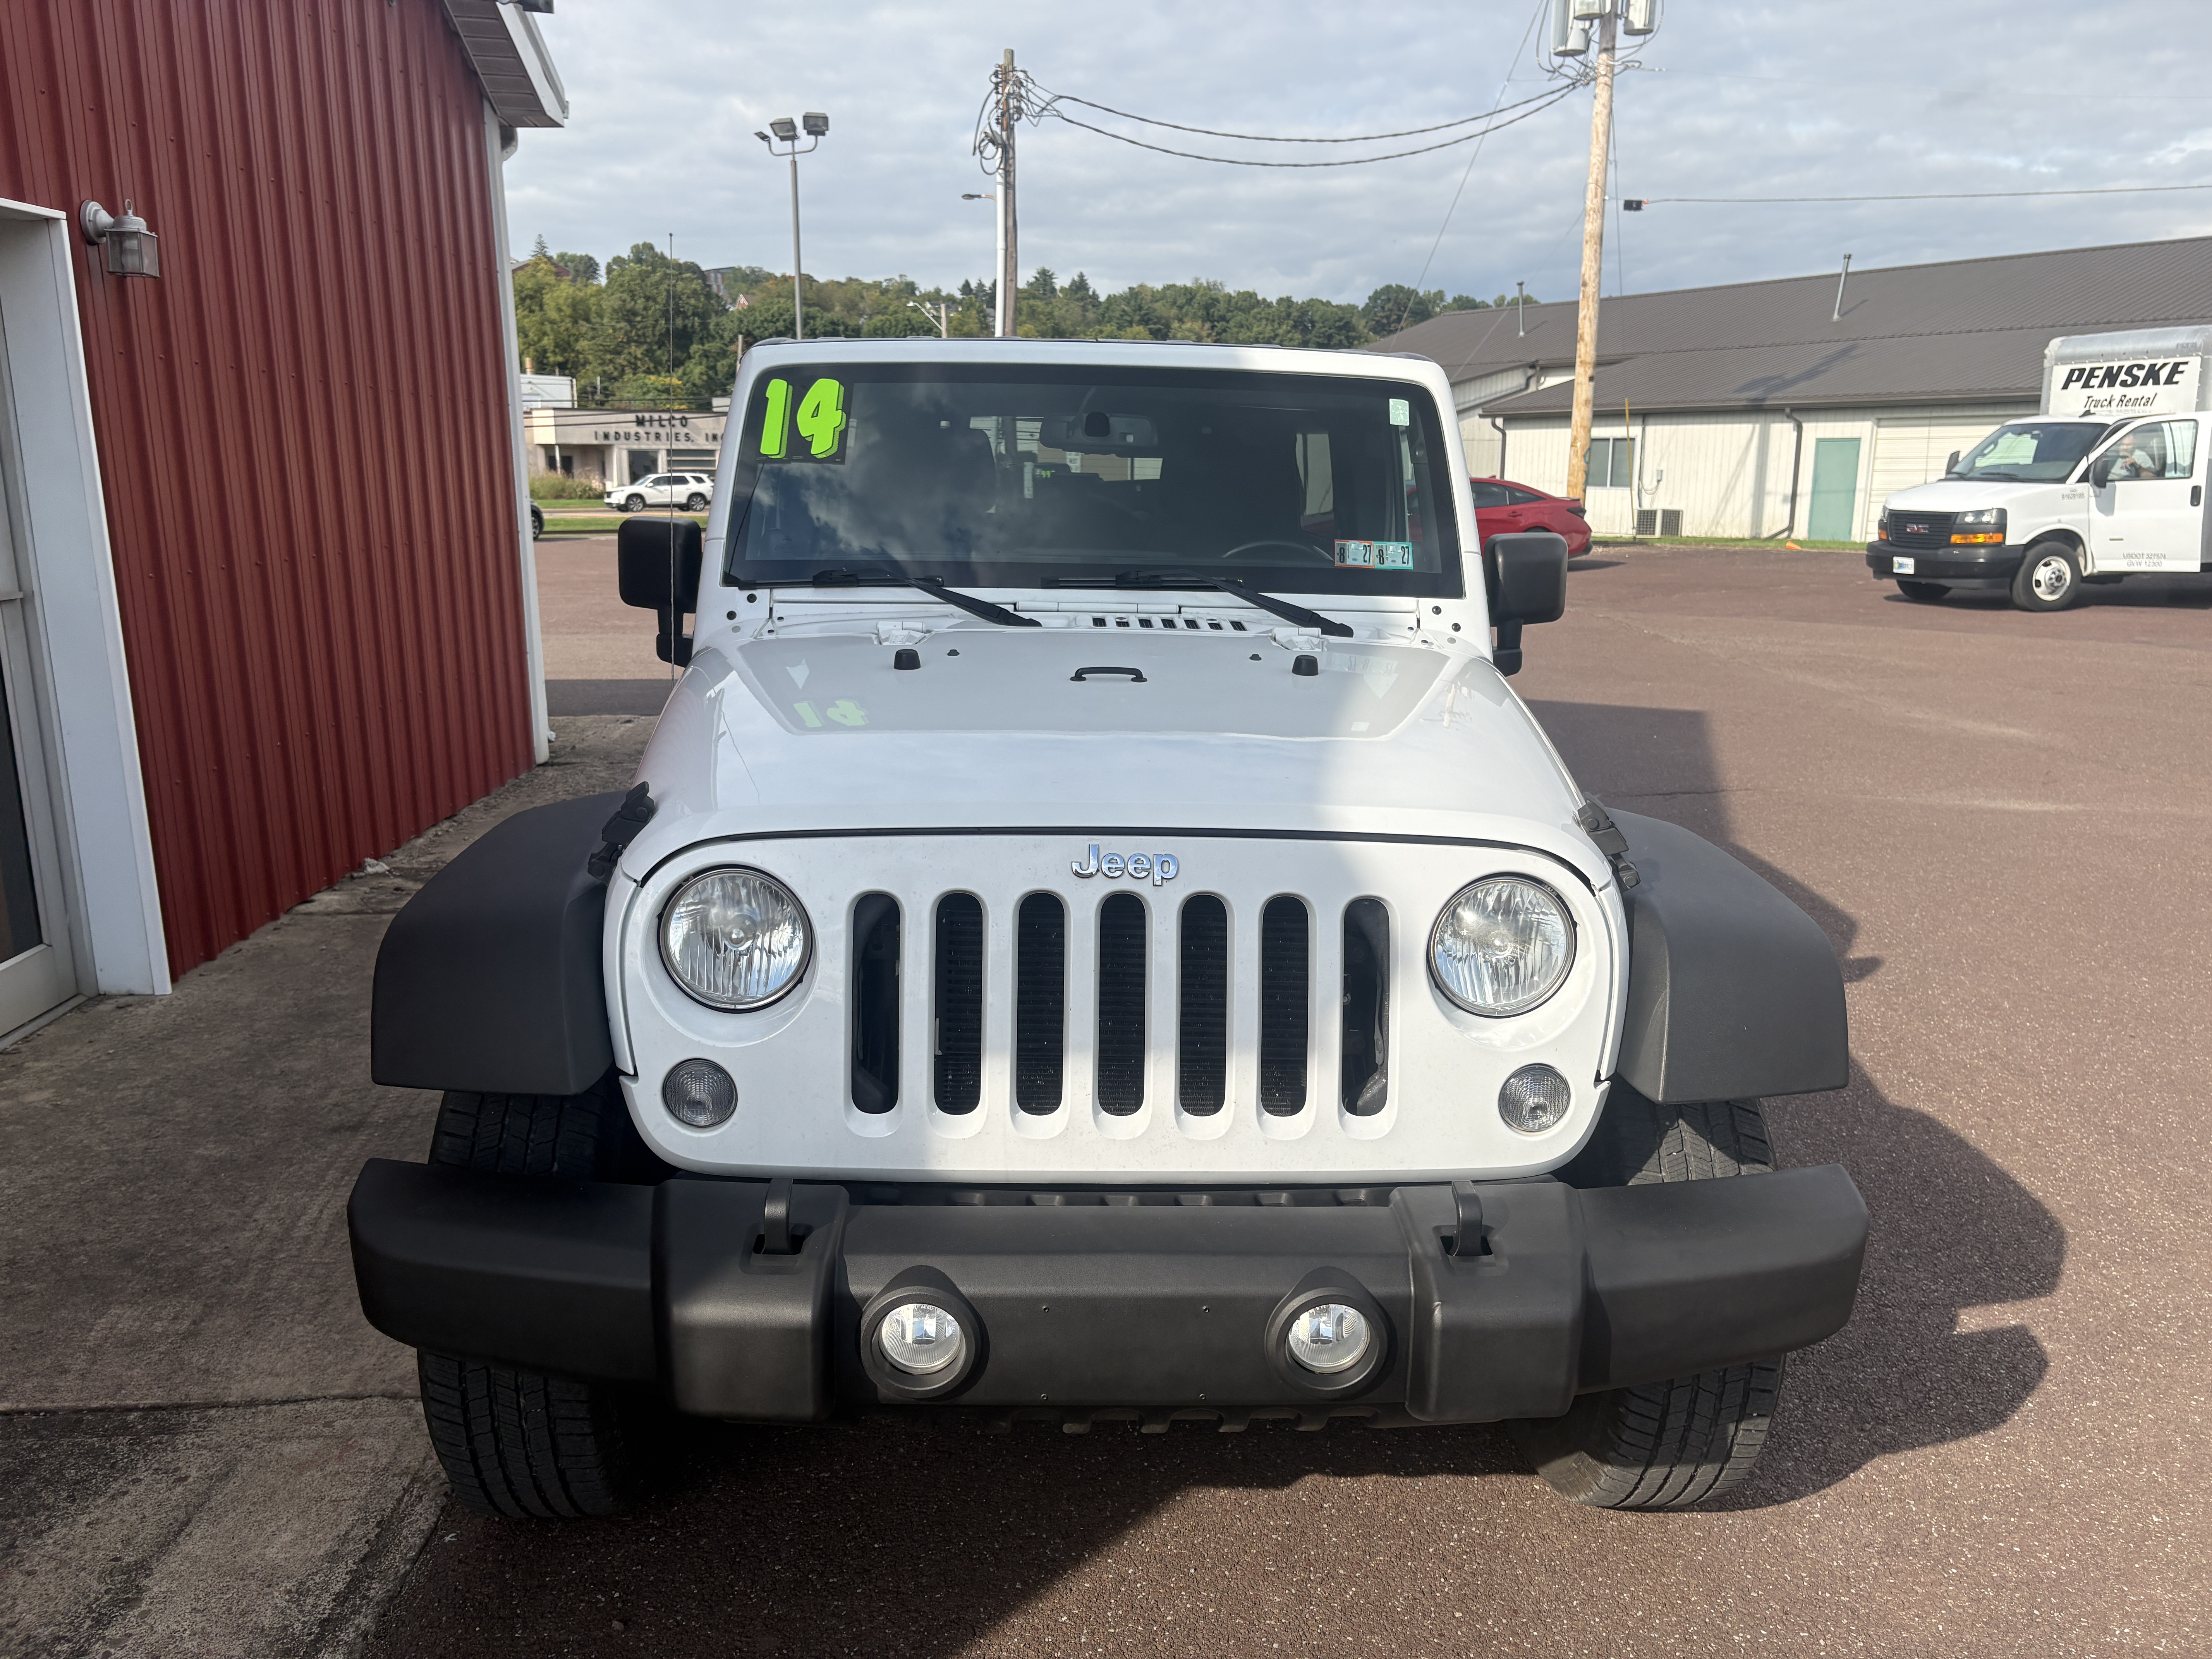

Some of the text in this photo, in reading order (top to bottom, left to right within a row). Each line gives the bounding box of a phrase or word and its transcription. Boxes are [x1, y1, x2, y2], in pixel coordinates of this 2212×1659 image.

[2061, 361, 2190, 390] PENSKE
[2083, 392, 2158, 409] Truck Rental
[635, 415, 688, 428] MILCO
[760, 378, 846, 459] 14
[1339, 547, 1345, 563] 8
[1363, 544, 1371, 563] 27
[1378, 549, 1384, 565] 8
[1401, 546, 1409, 565] 27
[1071, 843, 1178, 886] Jeep
